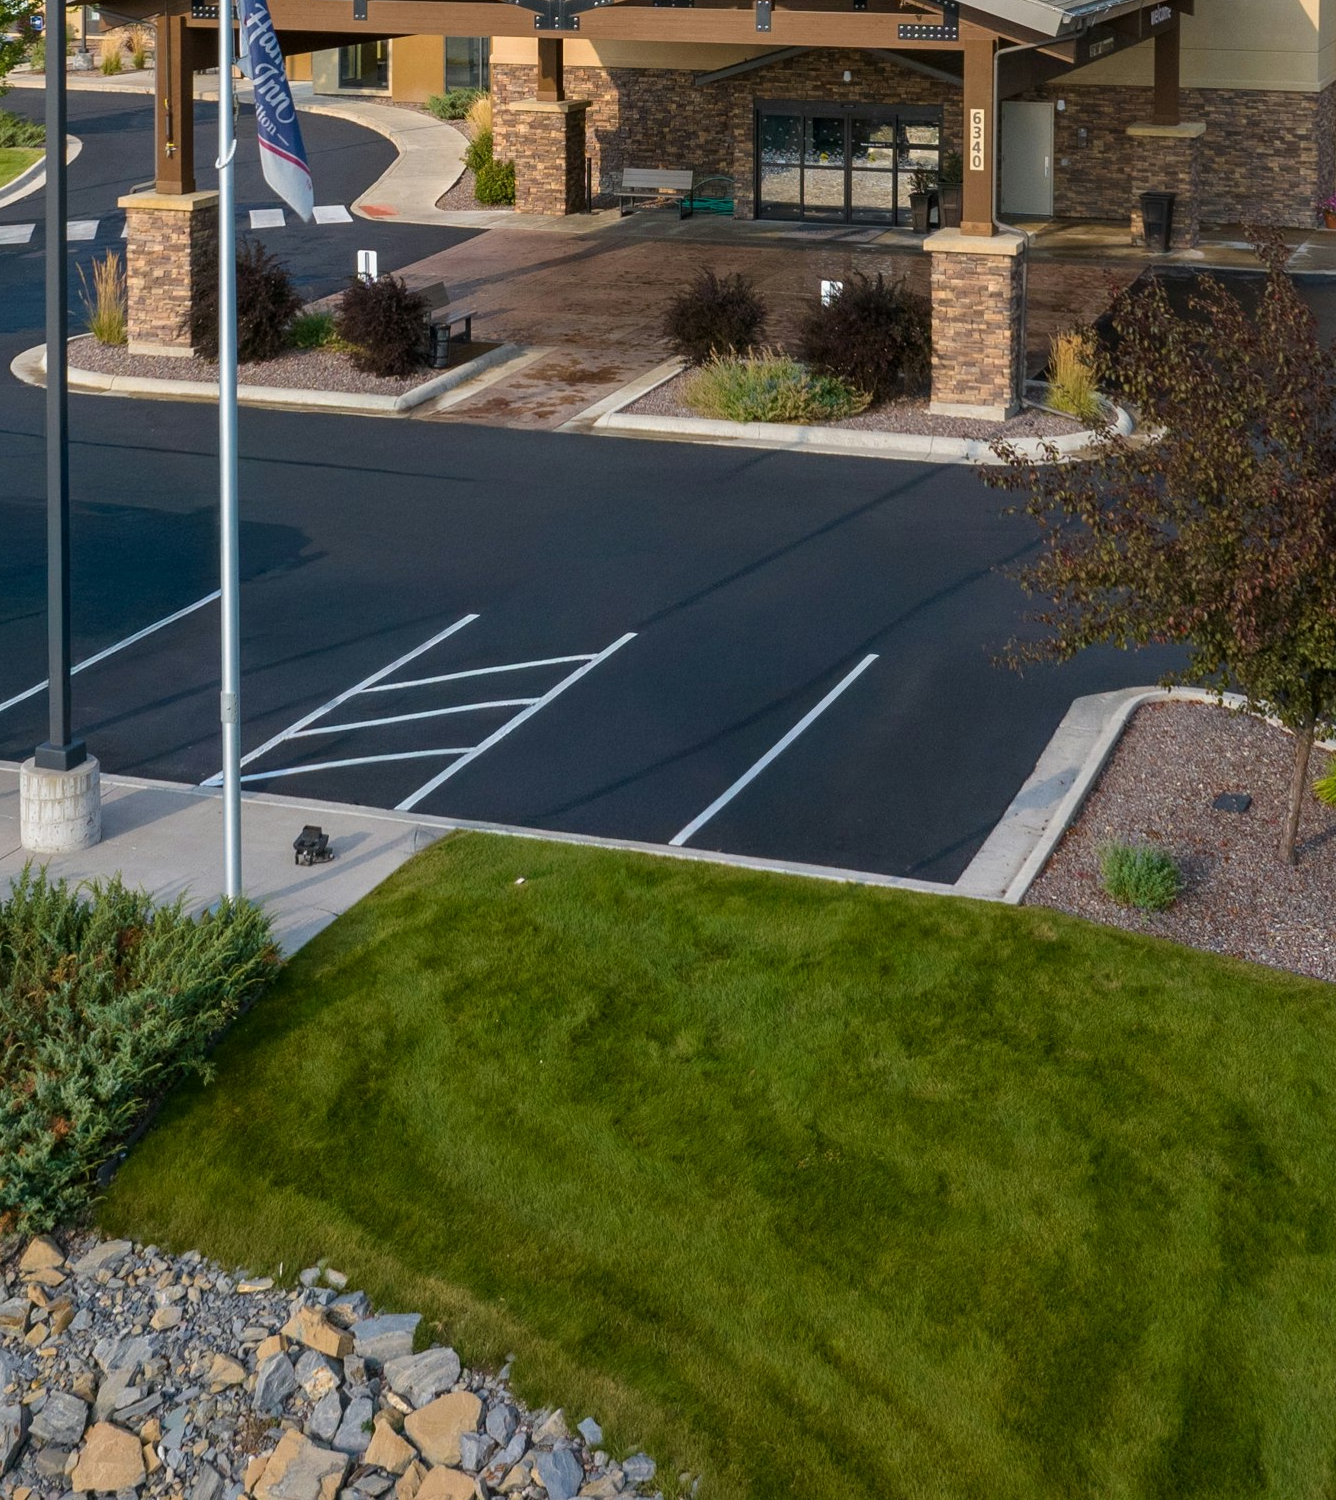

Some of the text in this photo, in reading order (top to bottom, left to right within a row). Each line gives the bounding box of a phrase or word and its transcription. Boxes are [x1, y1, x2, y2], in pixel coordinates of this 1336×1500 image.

[246, 3, 285, 82] Ham
[253, 63, 295, 124] Inn
[972, 111, 982, 168] 6340
